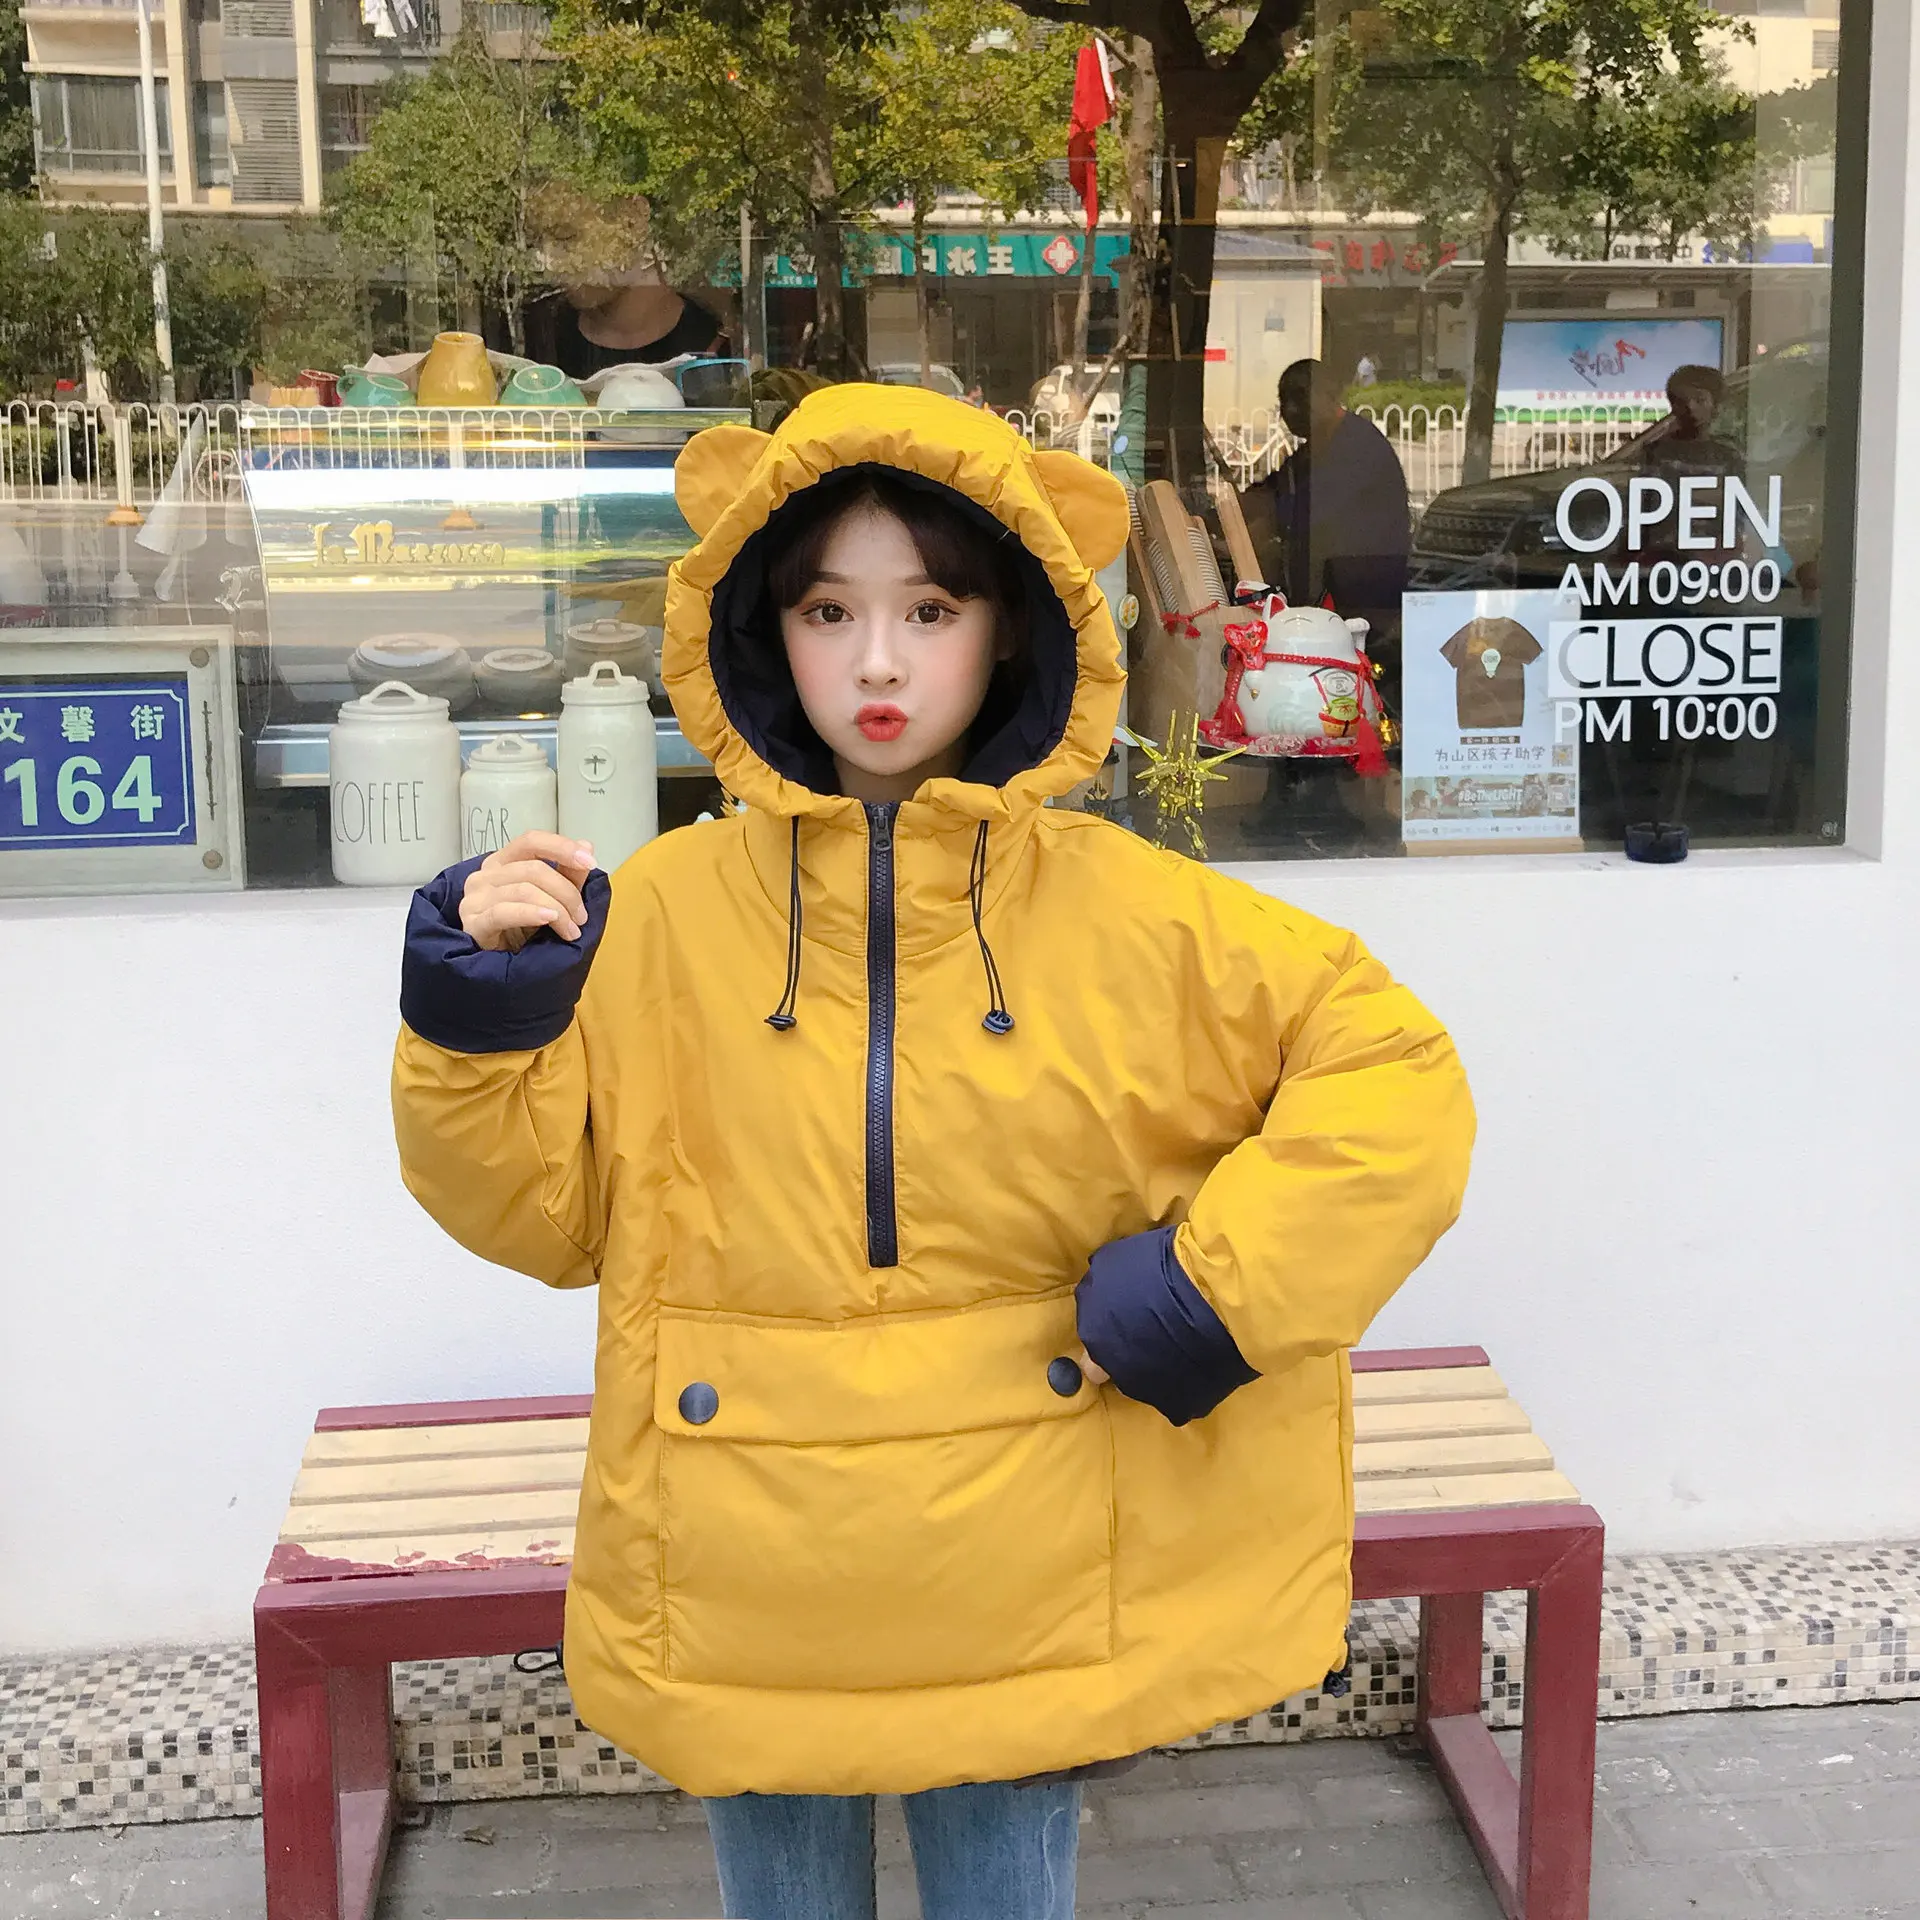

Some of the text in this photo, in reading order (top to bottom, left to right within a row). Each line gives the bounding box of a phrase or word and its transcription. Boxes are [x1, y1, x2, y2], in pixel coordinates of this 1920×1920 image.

[1556, 475, 1782, 553] OPEN
[1554, 559, 1782, 606] AM 09:00
[1557, 622, 1778, 690] CLOSE
[0, 704, 165, 743] 文馨街
[1554, 696, 1778, 744] PM 10:00
[1435, 745, 1546, 762] 为山区孩子助学
[4, 755, 163, 826] 164
[332, 780, 426, 845] COFFEE
[461, 806, 512, 855] UGAR
